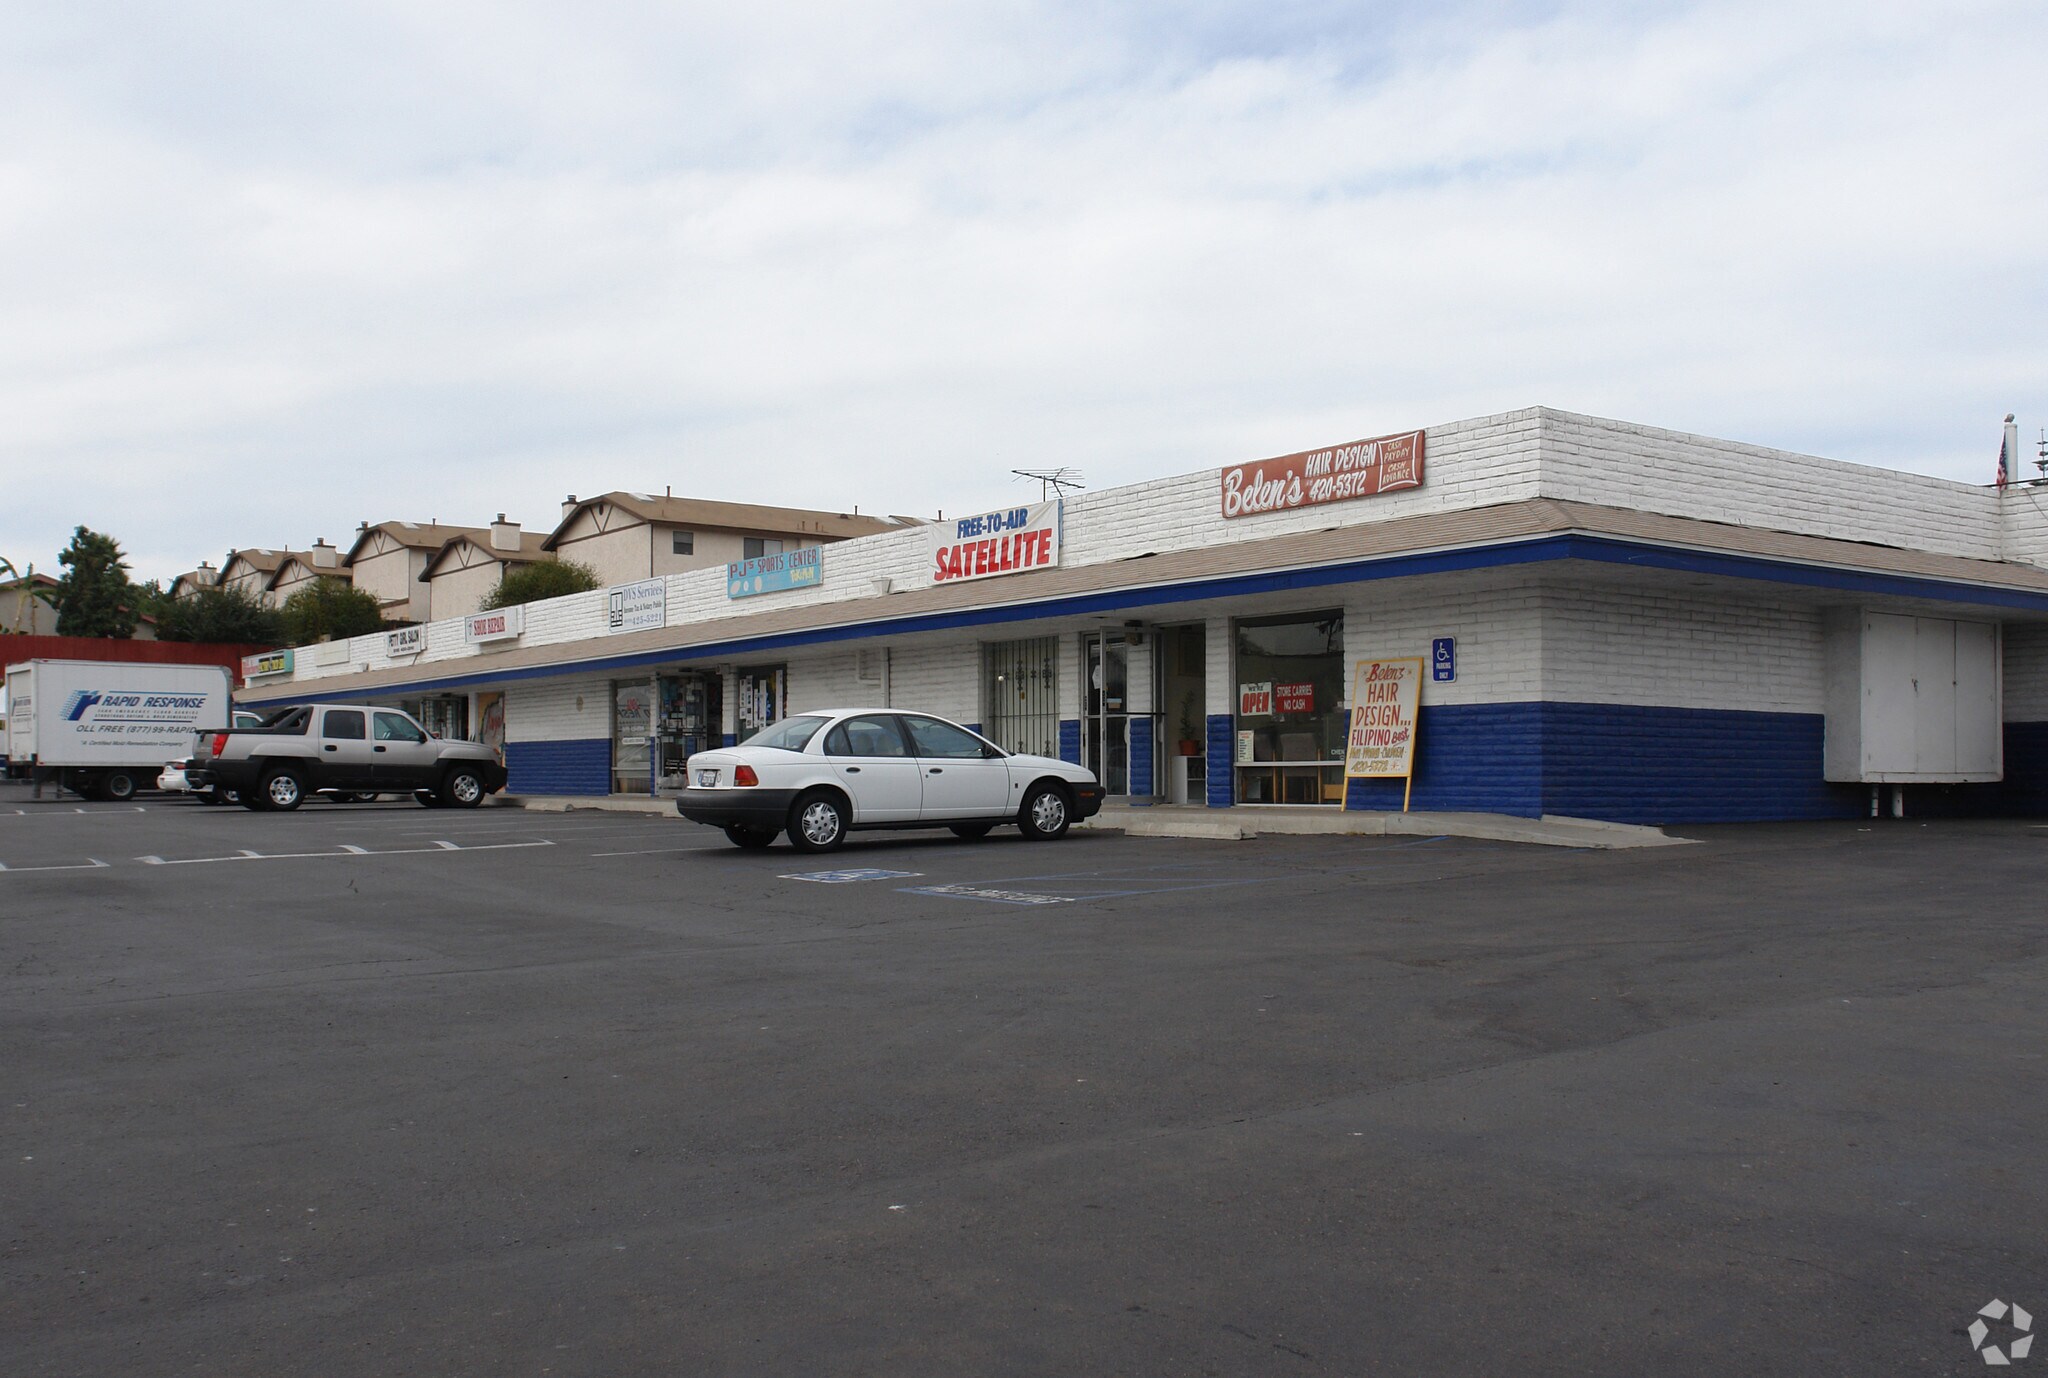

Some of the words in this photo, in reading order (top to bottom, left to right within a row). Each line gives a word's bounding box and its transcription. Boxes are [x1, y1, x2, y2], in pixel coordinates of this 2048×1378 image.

[1388, 440, 1402, 451] CASH
[1305, 451, 1330, 478] HAIR
[1334, 442, 1377, 472] DESIGN
[1384, 446, 1410, 463] PAYDAY
[1388, 461, 1406, 472] CASH
[1382, 468, 1410, 485] ADVANCE
[1223, 468, 1304, 517] Belen's
[1308, 470, 1367, 502] 420-5372
[957, 508, 1028, 539] FREE-TO-AIR
[757, 555, 784, 574] SPORTS
[789, 549, 817, 568] CENTER
[934, 528, 1052, 581] SATELLITE
[637, 584, 663, 599] Services
[474, 620, 487, 636] SHOE
[487, 616, 506, 635] REPAIR
[408, 629, 419, 643] SALON
[1277, 686, 1291, 697] STORE
[1292, 684, 1312, 697] CARRIES
[1367, 682, 1399, 703] HAIR
[101, 696, 141, 706] RAPID
[143, 696, 206, 708] RESPONSE
[1242, 692, 1270, 714] OPEN
[1283, 700, 1291, 710] NO
[1292, 699, 1306, 710] CASH
[98, 725, 125, 733] FREE
[1351, 729, 1391, 746] FILIPINO
